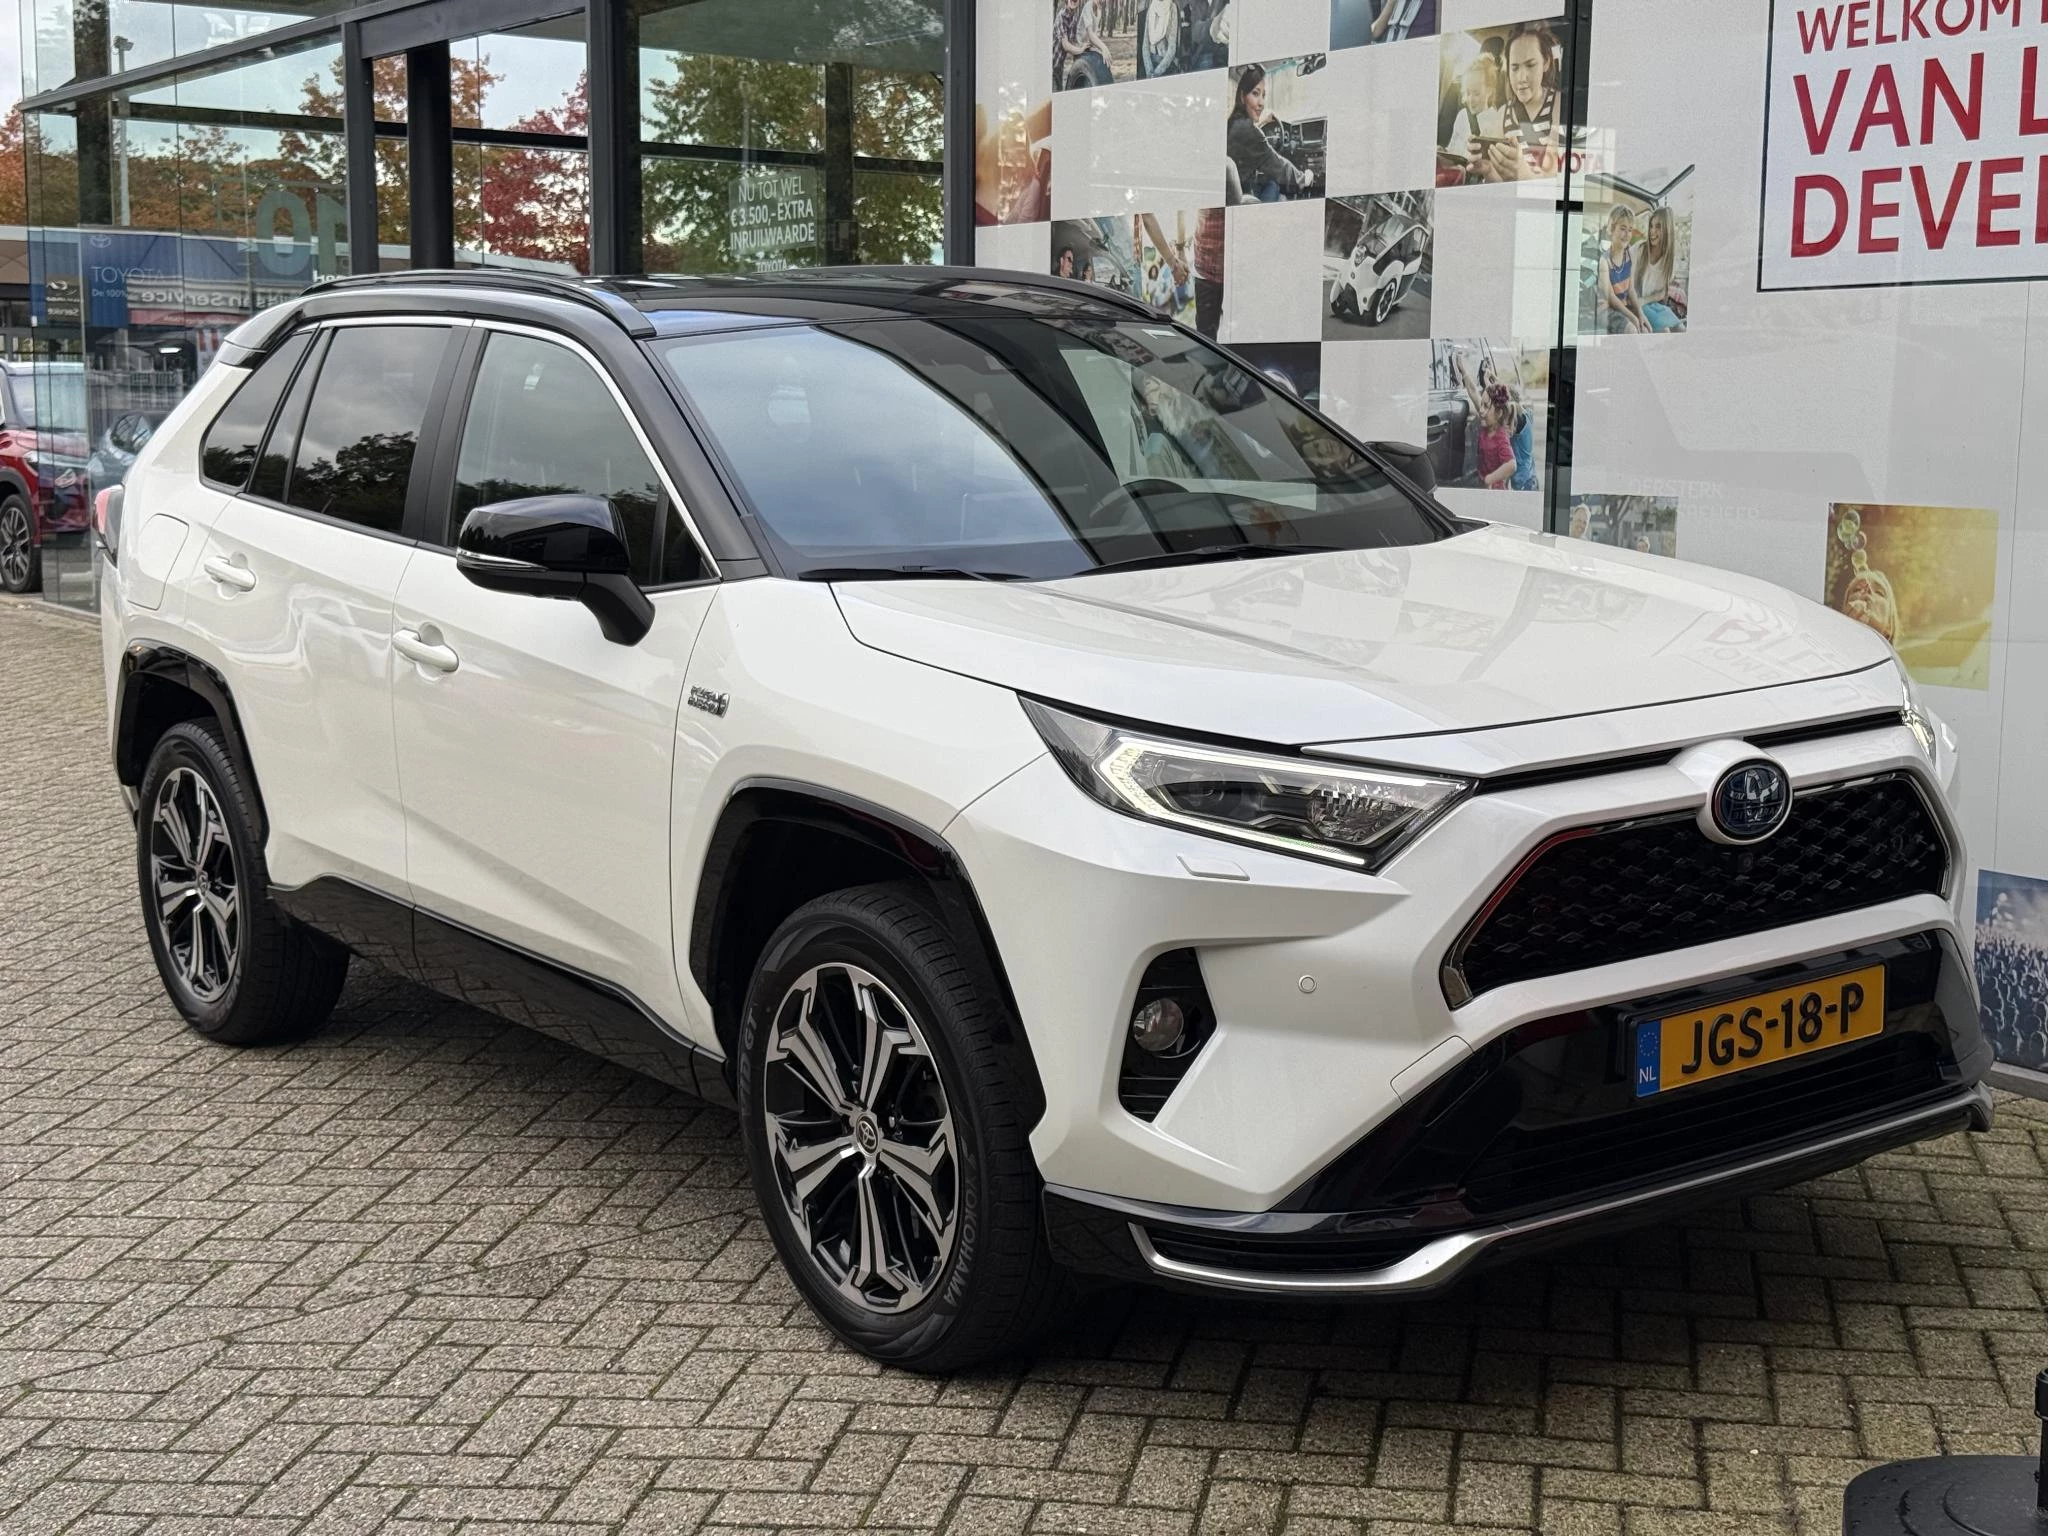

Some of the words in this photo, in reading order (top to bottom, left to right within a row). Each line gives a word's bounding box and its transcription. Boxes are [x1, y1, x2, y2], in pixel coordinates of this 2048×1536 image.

[1797, 0, 2020, 54] WELKOM
[1793, 51, 1984, 155] VAN
[738, 181, 755, 203] NU
[757, 180, 778, 200] TOT
[780, 176, 805, 196] WEL
[1791, 155, 2048, 258] DEVE
[777, 199, 814, 221] EXTRA
[730, 223, 815, 250] INRUILWAARDE
[755, 260, 787, 272] TOYOTA
[1682, 982, 1864, 1075] JGS-18-P
[1639, 1066, 1656, 1084] NL
[943, 1173, 978, 1306] YOKOHAMA
